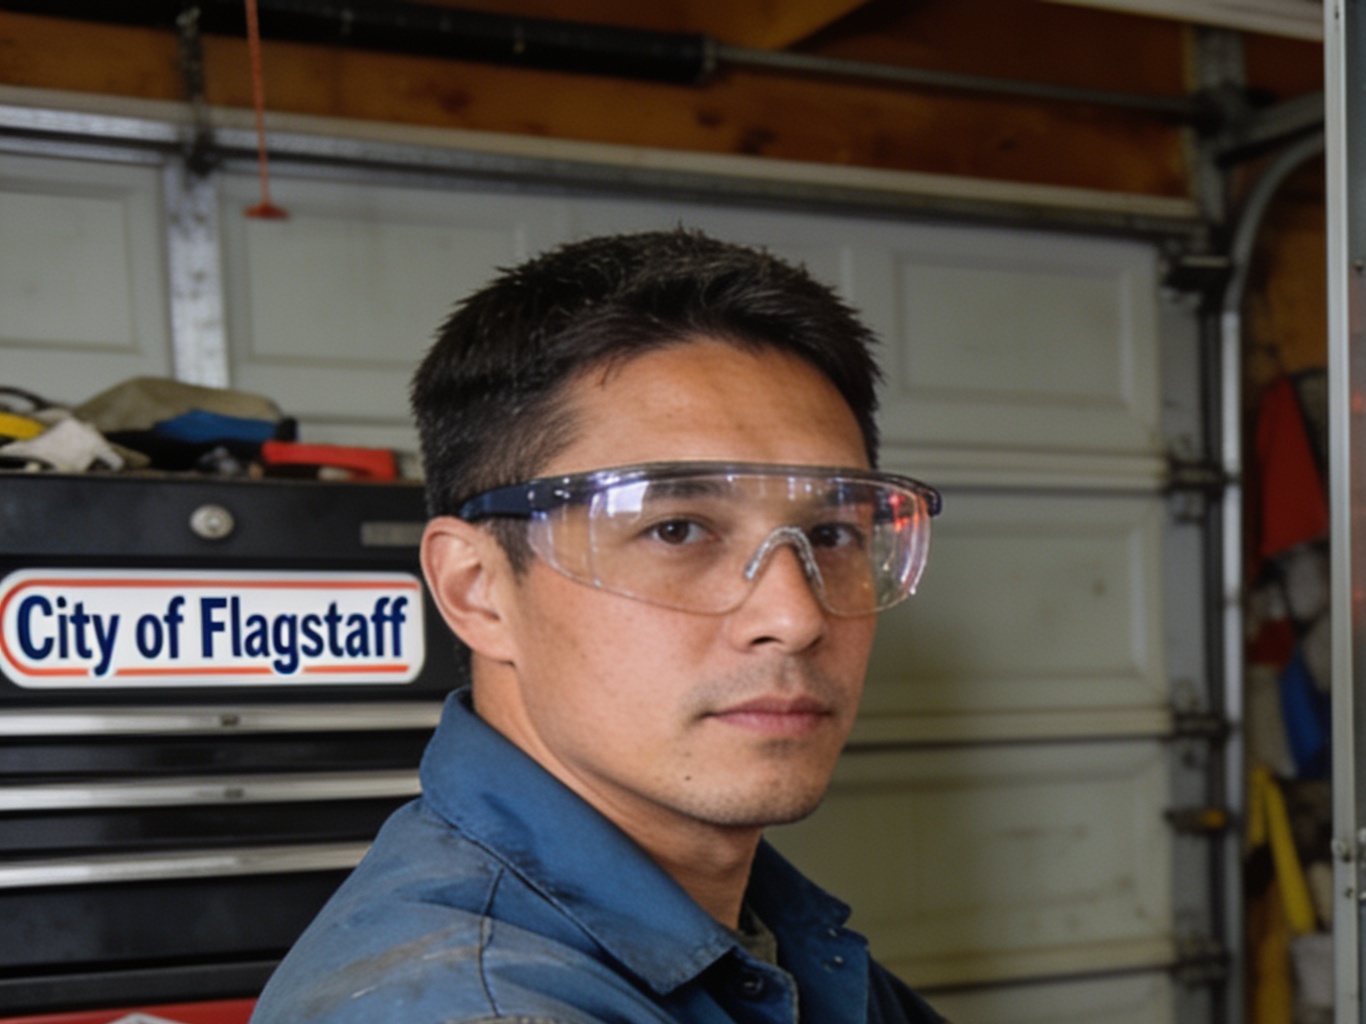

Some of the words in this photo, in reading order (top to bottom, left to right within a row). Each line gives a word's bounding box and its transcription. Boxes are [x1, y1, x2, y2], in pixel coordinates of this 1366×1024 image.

[17, 595, 120, 676] City
[136, 596, 185, 659] of
[200, 595, 409, 675] Flagstaff
